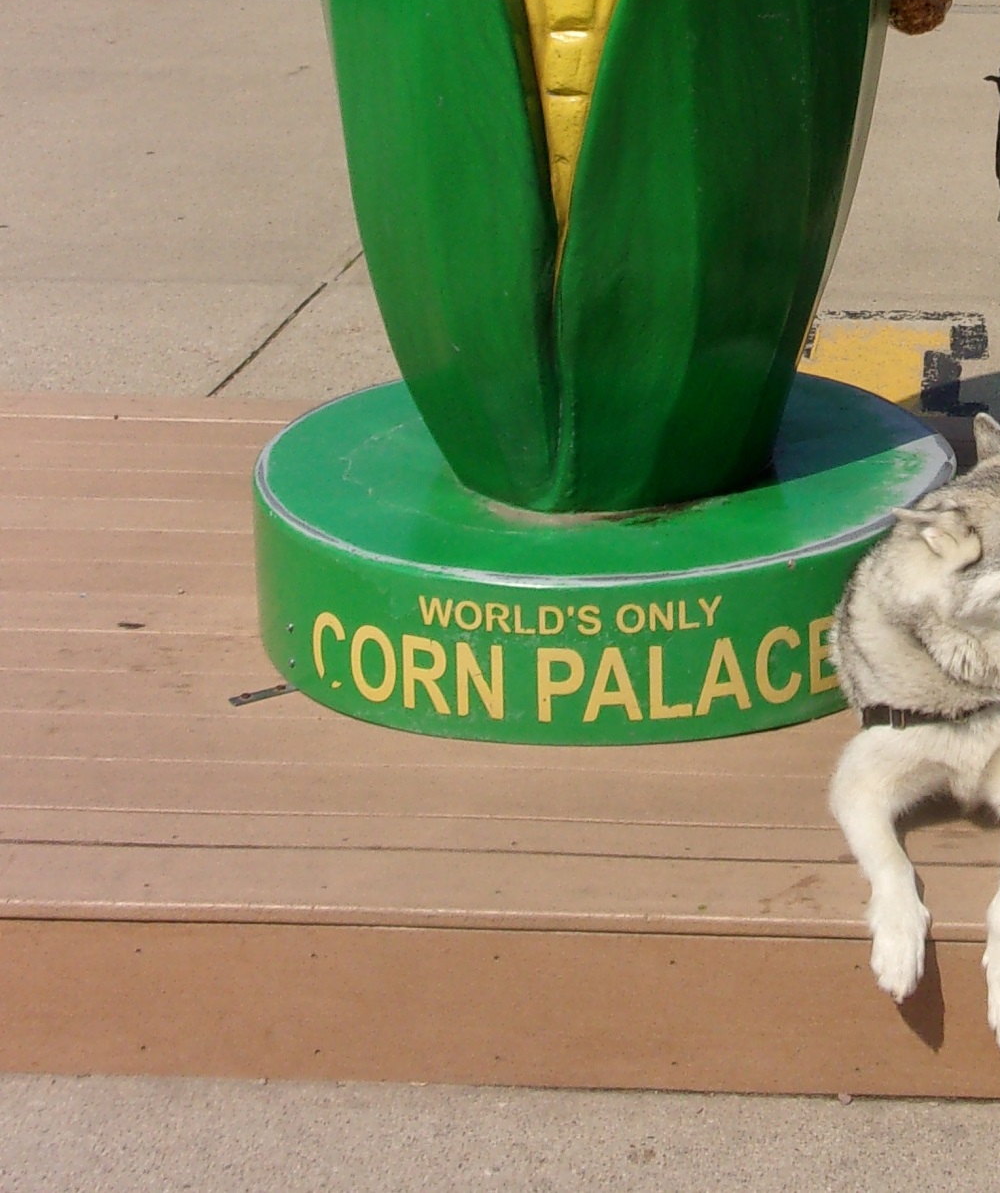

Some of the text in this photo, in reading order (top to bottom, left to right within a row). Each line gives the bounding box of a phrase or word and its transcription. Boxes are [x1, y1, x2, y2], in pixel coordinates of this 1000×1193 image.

[418, 595, 723, 635] WORLD'S ONLY
[312, 611, 841, 723] CORN PALACE
